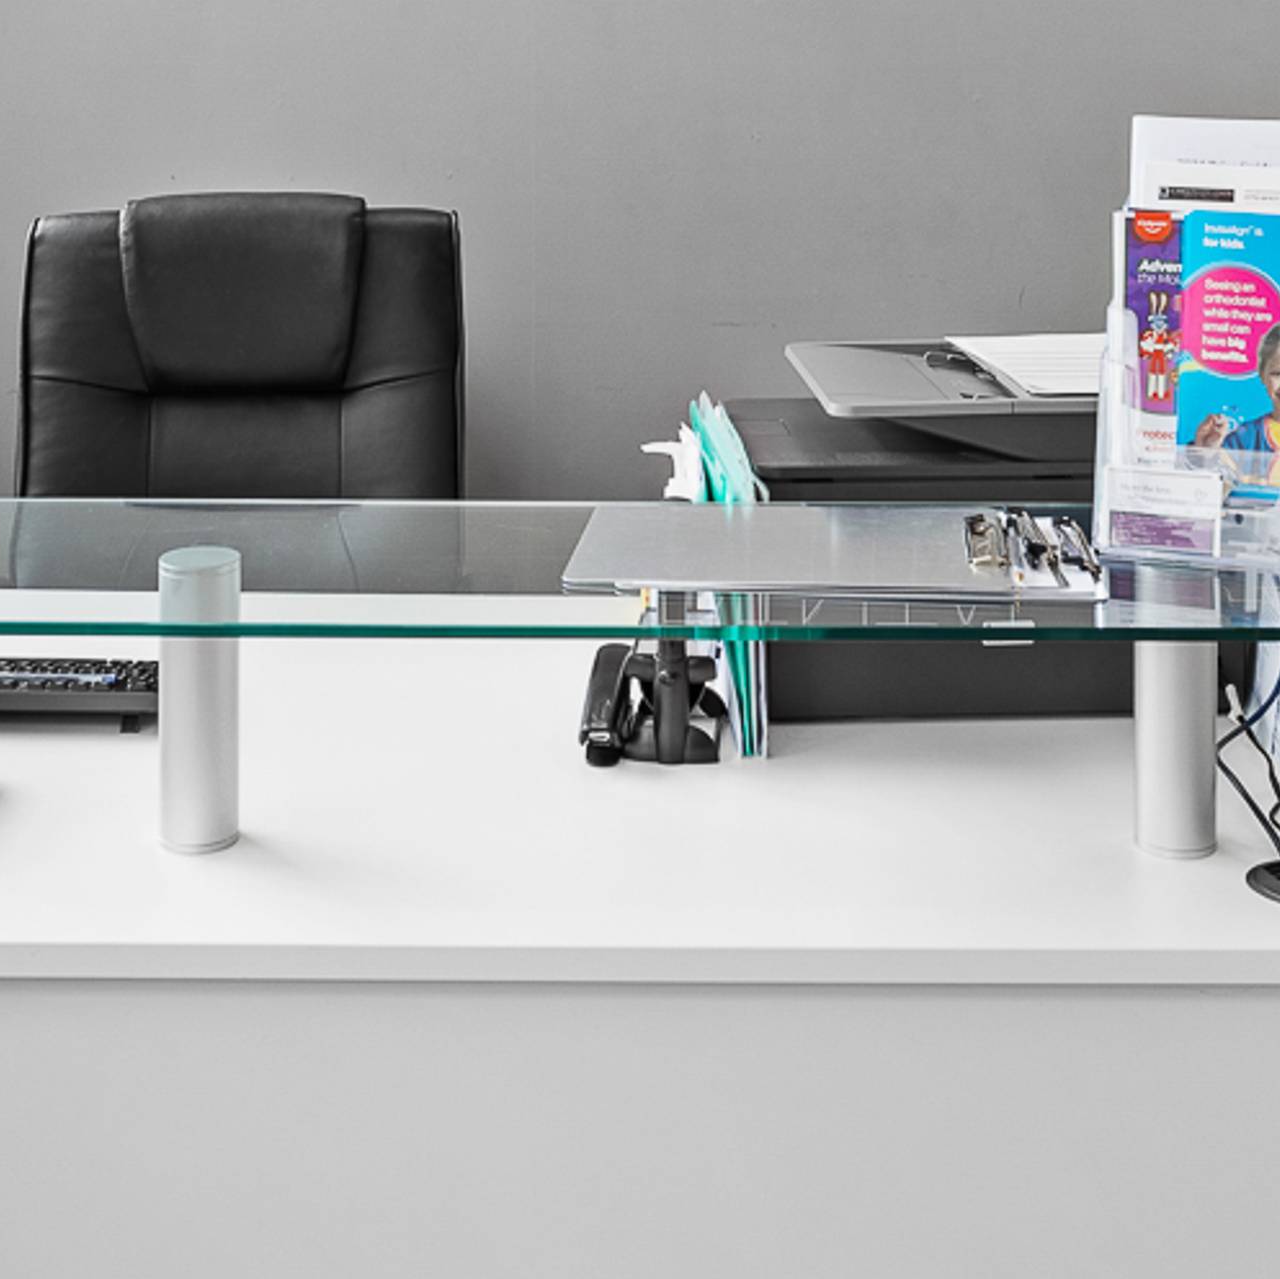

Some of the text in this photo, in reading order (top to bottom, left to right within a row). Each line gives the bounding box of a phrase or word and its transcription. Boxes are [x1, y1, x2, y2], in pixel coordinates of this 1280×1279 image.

[1204, 278, 1241, 293] Seeing
[1203, 294, 1267, 308] orthodontist
[1203, 308, 1229, 320] while
[1231, 309, 1253, 322] they
[1202, 322, 1251, 334] small can
[1202, 335, 1246, 350] have big
